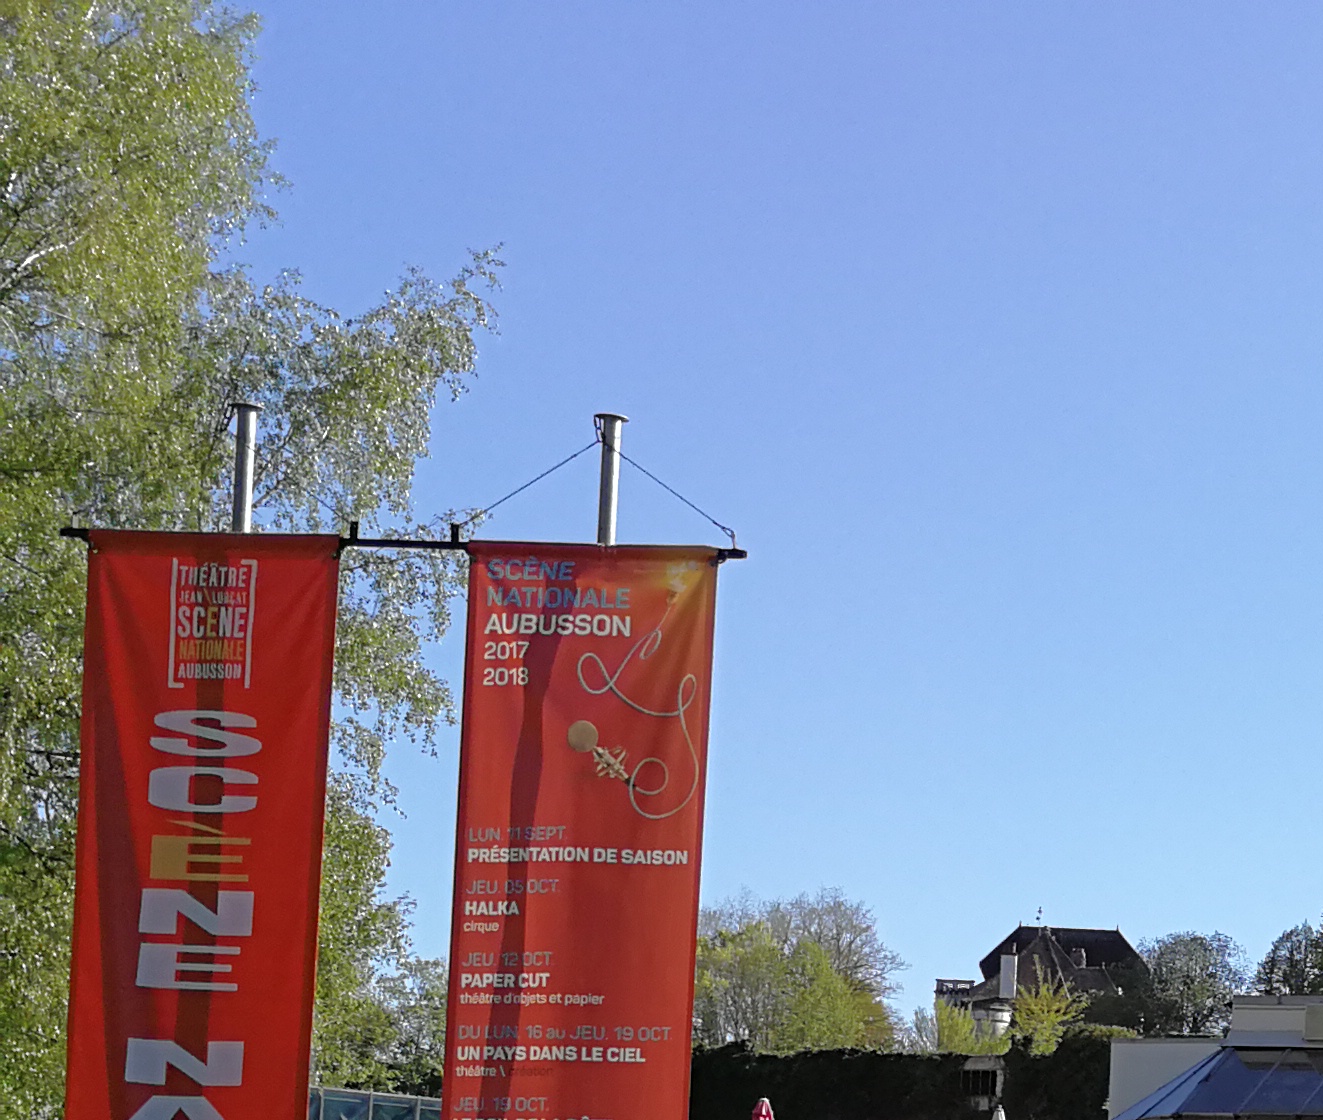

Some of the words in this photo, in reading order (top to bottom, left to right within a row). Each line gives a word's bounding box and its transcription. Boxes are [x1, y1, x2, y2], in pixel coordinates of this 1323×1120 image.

[180, 562, 247, 587] THÉÂTRE
[487, 558, 575, 580] SCÈNE
[487, 587, 630, 609] NATIONALE
[484, 614, 631, 637] AUBUSSON
[180, 640, 244, 660] NATIONALE
[484, 641, 529, 660] 2017
[178, 663, 242, 679] AUBUSSON
[483, 667, 529, 686] 2018
[468, 846, 589, 863] PRÉSENTATION
[593, 849, 617, 863] DE
[621, 850, 688, 864] SAISON
[464, 901, 520, 916] HALKA
[464, 922, 499, 933] cirque
[461, 973, 515, 988] PAPER
[518, 973, 550, 988] CUT
[460, 994, 500, 1003] théâtre
[549, 994, 562, 1003] et
[565, 994, 604, 1006] papier
[457, 1046, 480, 1061] UN
[484, 1046, 526, 1061] PAYS
[530, 1046, 577, 1061] DANS
[581, 1047, 603, 1062] LE
[607, 1048, 645, 1062] CIEL
